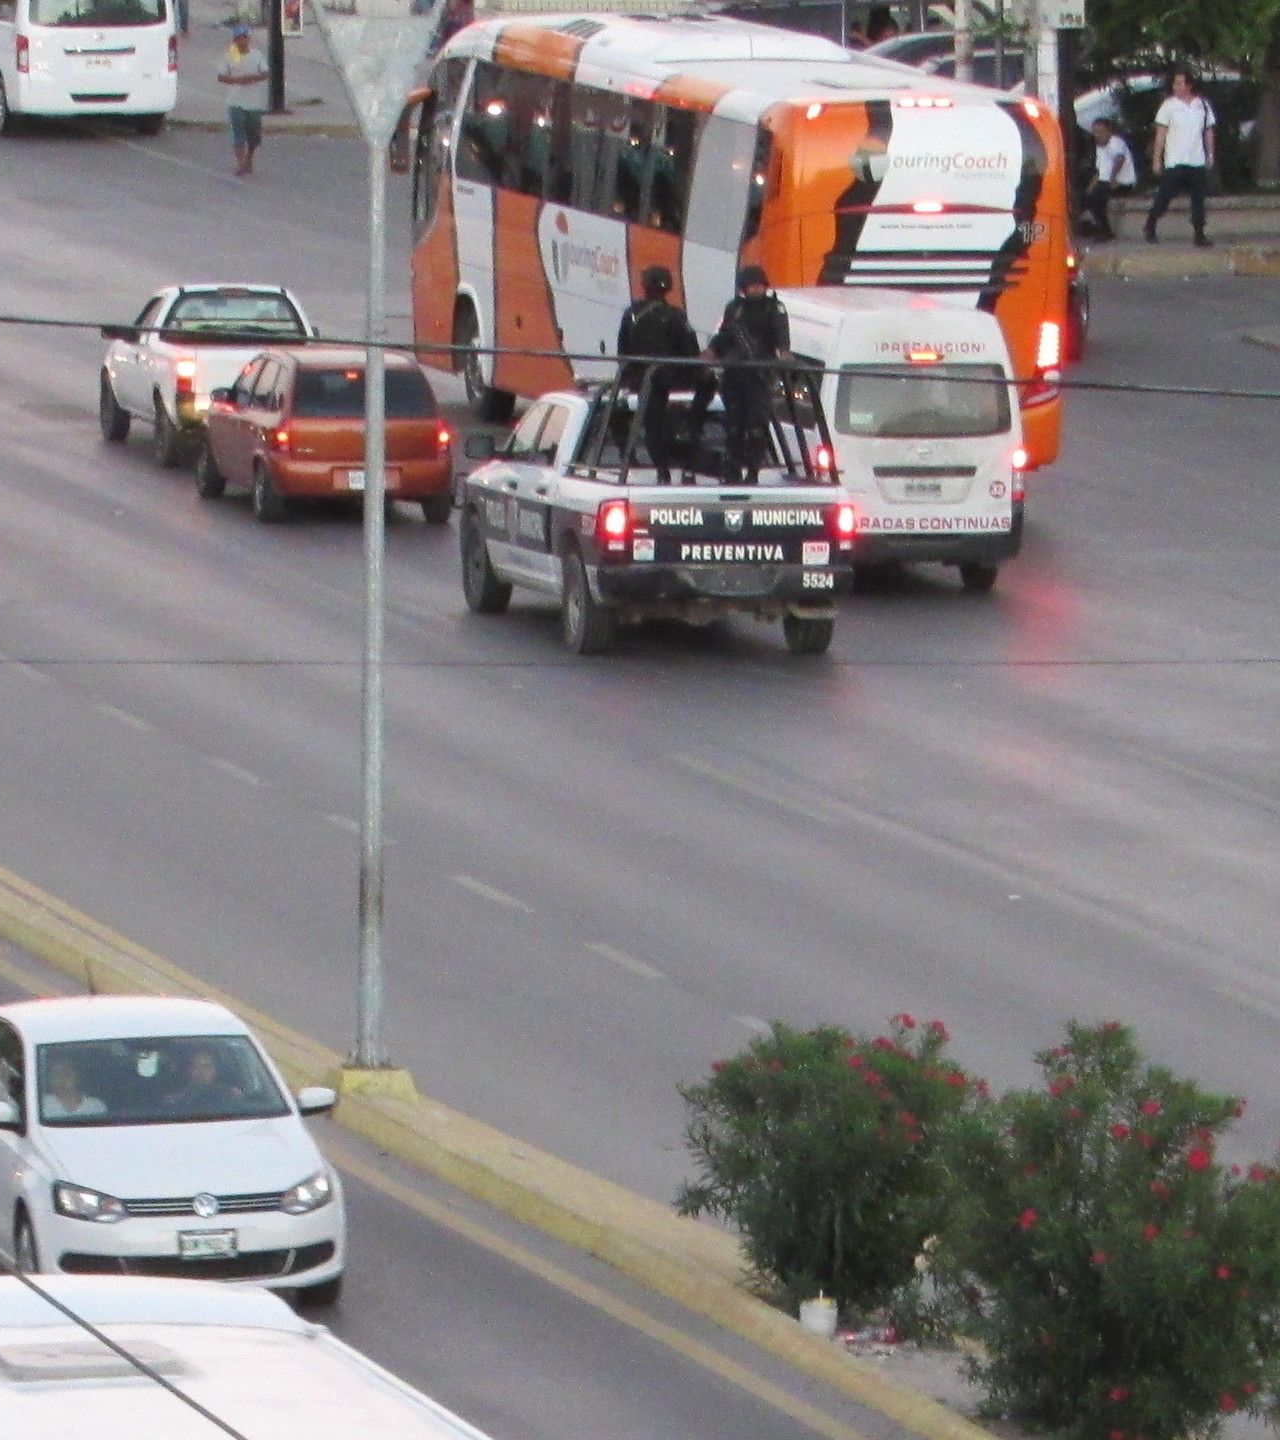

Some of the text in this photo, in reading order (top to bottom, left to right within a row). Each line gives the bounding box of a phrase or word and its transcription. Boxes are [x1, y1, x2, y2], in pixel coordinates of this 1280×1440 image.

[650, 507, 824, 526] POLICÍA MUNICIPAL
[919, 517, 1011, 530] CONTINUAS
[681, 543, 784, 561] PREVENTIVA
[802, 572, 835, 589] 5524
